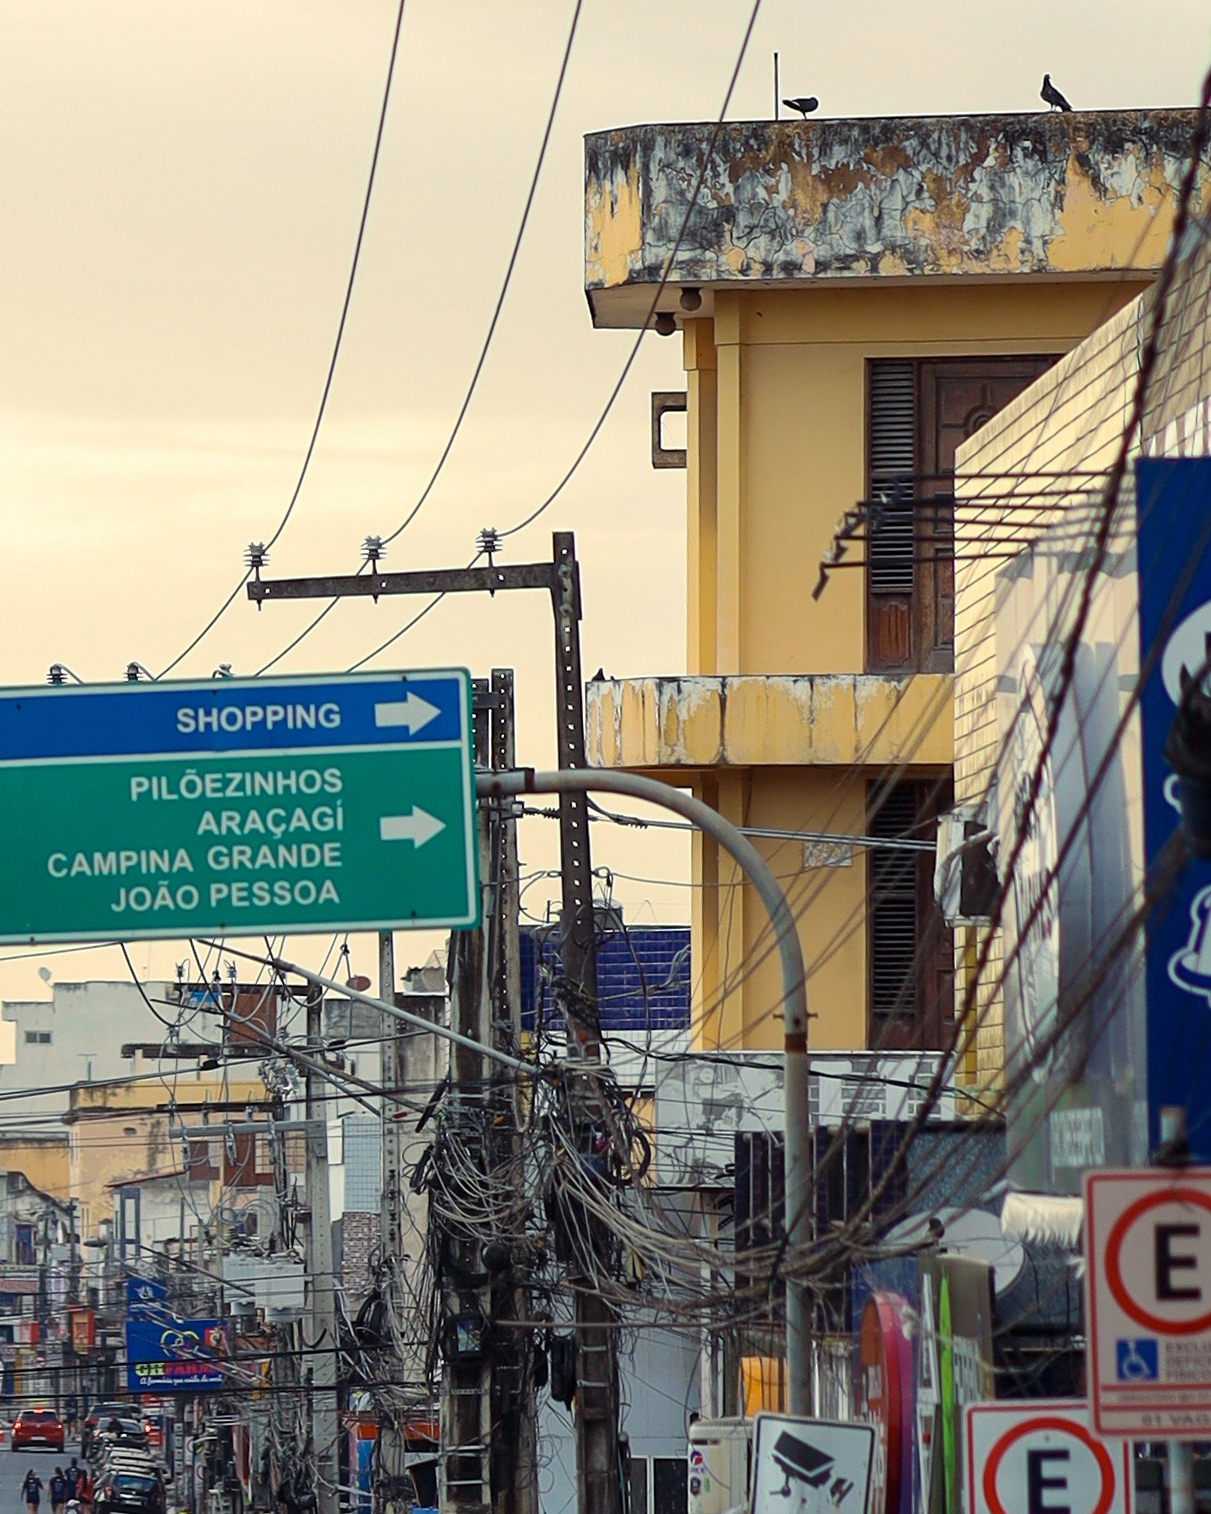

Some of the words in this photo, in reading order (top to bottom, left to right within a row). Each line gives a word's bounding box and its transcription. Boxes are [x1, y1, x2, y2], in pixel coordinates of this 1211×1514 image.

[176, 703, 341, 733] SHOPPING
[130, 768, 343, 801] PILÕEZINHOS
[197, 800, 344, 839] ARAÇAGÍ
[47, 848, 193, 878] CAMPINA
[207, 842, 343, 869] GRANDE
[111, 880, 199, 912] JOÃO
[209, 880, 339, 908] PESSOA
[1154, 1224, 1201, 1300] E
